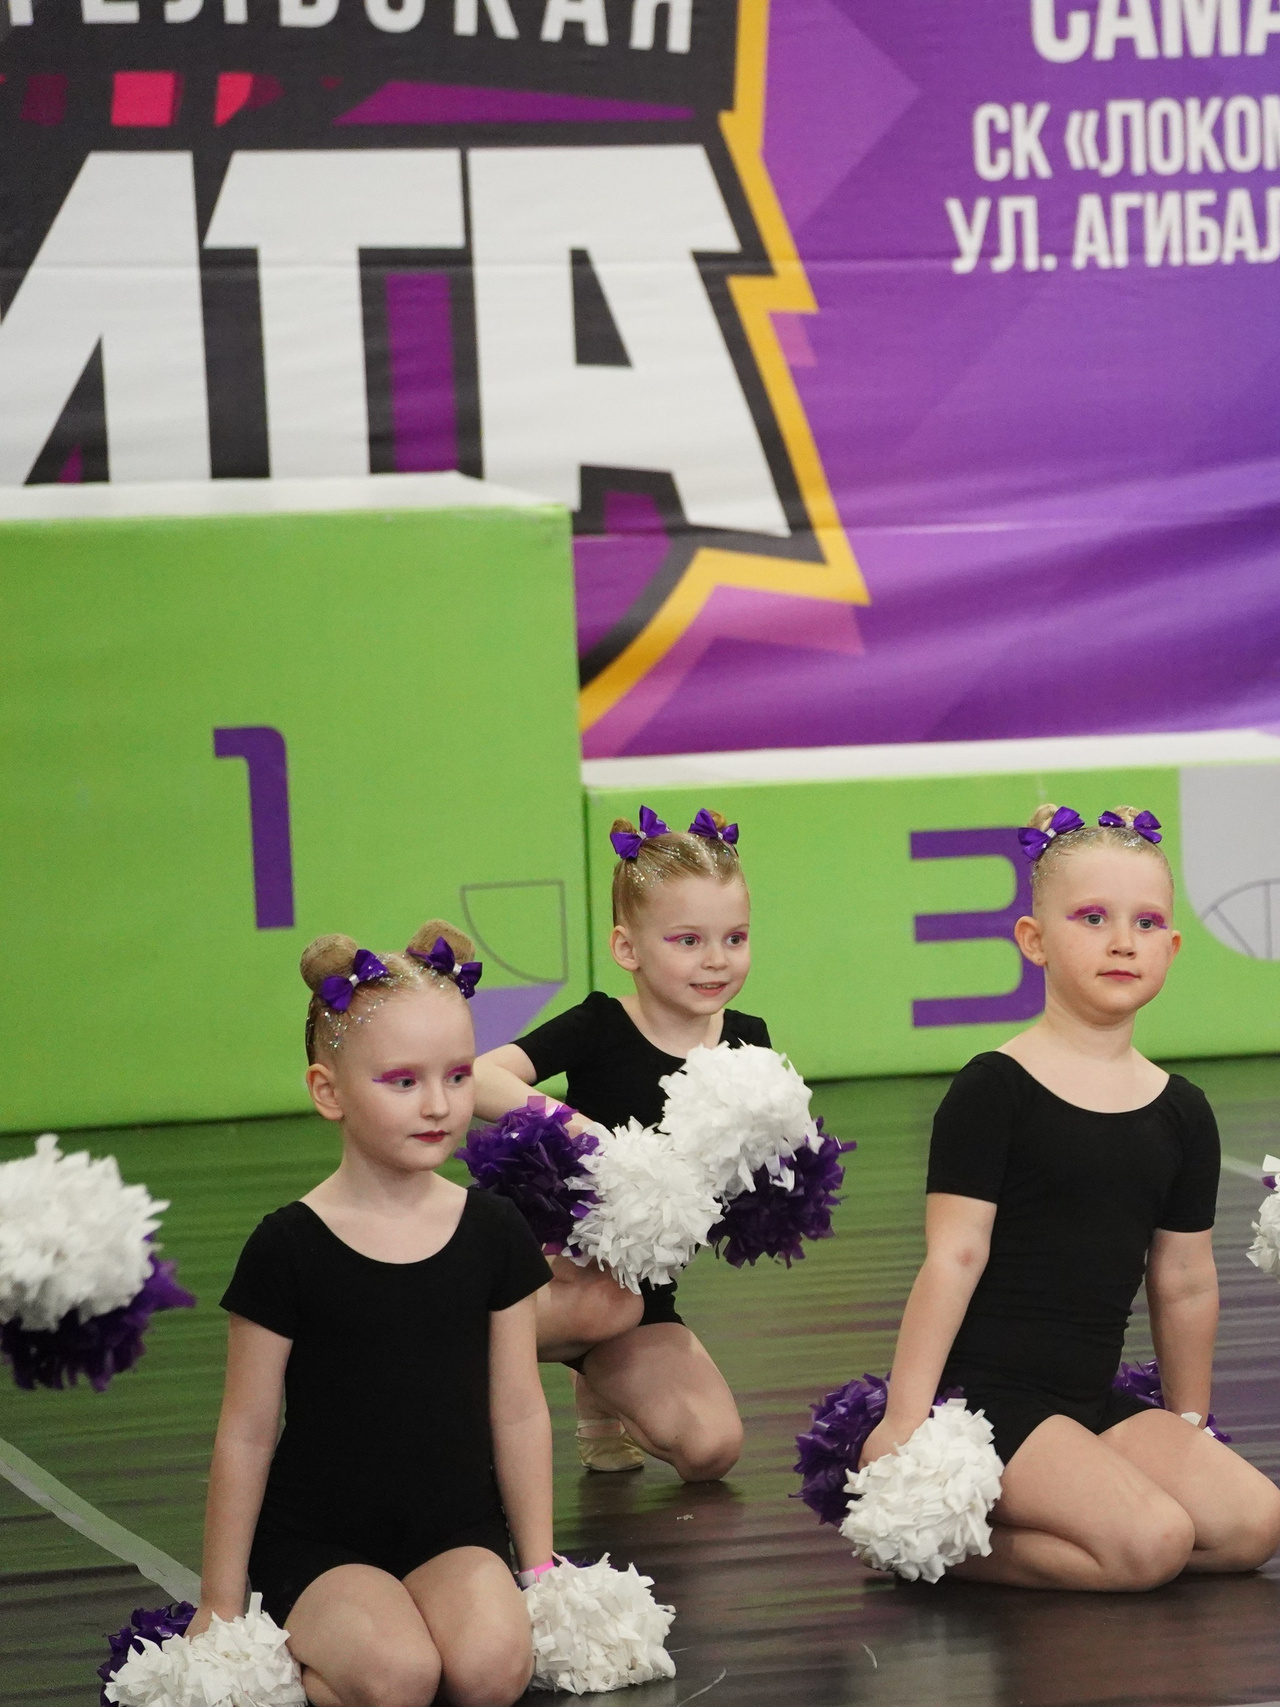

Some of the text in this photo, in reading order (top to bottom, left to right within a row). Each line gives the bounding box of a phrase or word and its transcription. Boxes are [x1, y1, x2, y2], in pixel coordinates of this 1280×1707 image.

[973, 103, 1052, 181] СК
[946, 196, 1057, 274] УЛ.
[212, 727, 294, 928] 1
[909, 826, 1046, 1027] 3
